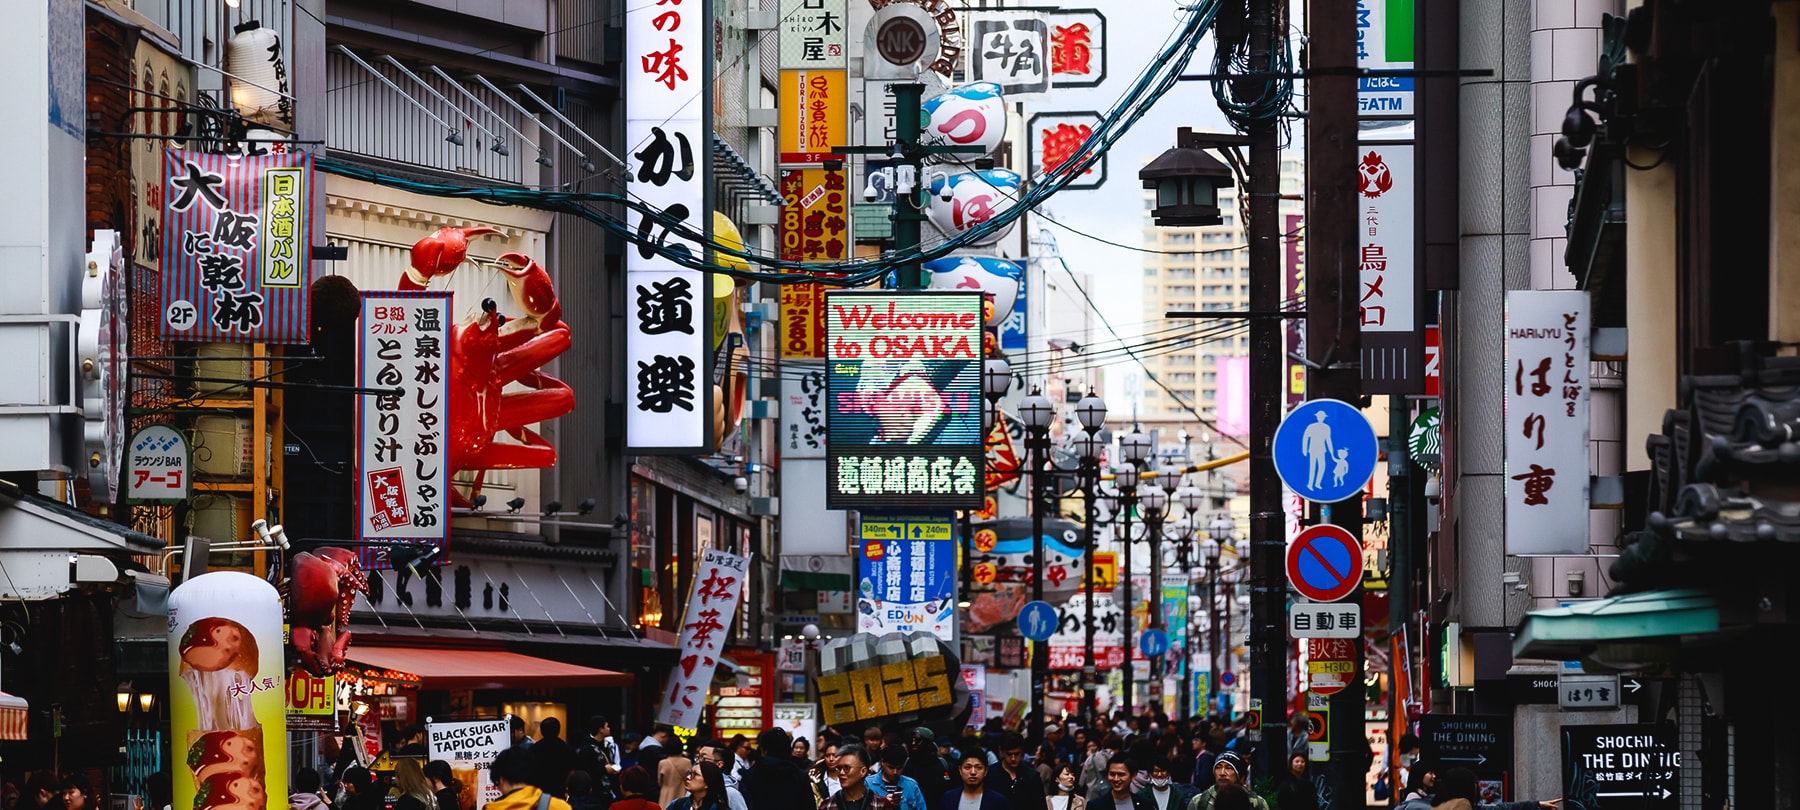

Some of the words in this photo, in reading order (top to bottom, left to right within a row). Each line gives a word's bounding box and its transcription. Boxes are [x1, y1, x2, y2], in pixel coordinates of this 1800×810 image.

[641, 0, 689, 91] の味
[887, 31, 915, 53] NK
[984, 34, 1042, 77] 牛角
[810, 75, 828, 148] 鳥貴族
[271, 175, 295, 279] 日本酒バル
[1366, 206, 1378, 236] 三代目
[1359, 243, 1388, 327] 鳥メロ
[170, 306, 194, 324] 2F
[375, 306, 405, 321] B級
[832, 301, 976, 331] Welcome
[370, 322, 408, 334] グルメ
[1510, 328, 1561, 339] HARIJYU
[834, 336, 862, 358] to
[868, 336, 977, 358] OSAKA
[413, 307, 442, 528] 温泉水しゃぶしゃぶ
[1510, 357, 1556, 506] はり重
[134, 456, 165, 467] ラウンジ
[165, 457, 182, 467] BAR
[134, 470, 182, 489] アーゴ
[864, 525, 887, 533] 340m
[926, 526, 949, 534] 240m
[887, 610, 924, 623] EDION
[1294, 612, 1357, 630] 自動車
[669, 568, 736, 708] 松葉かに
[818, 655, 952, 725] 2025
[432, 728, 468, 742] BLACK
[469, 722, 506, 737] SUGAR
[1441, 721, 1487, 730] SHOCHIKU
[434, 736, 494, 753] TAPIOCA
[1432, 732, 1453, 743] THE
[1456, 733, 1496, 743] DINING
[1596, 735, 1665, 748] SHOCHI
[1582, 754, 1615, 768] THE
